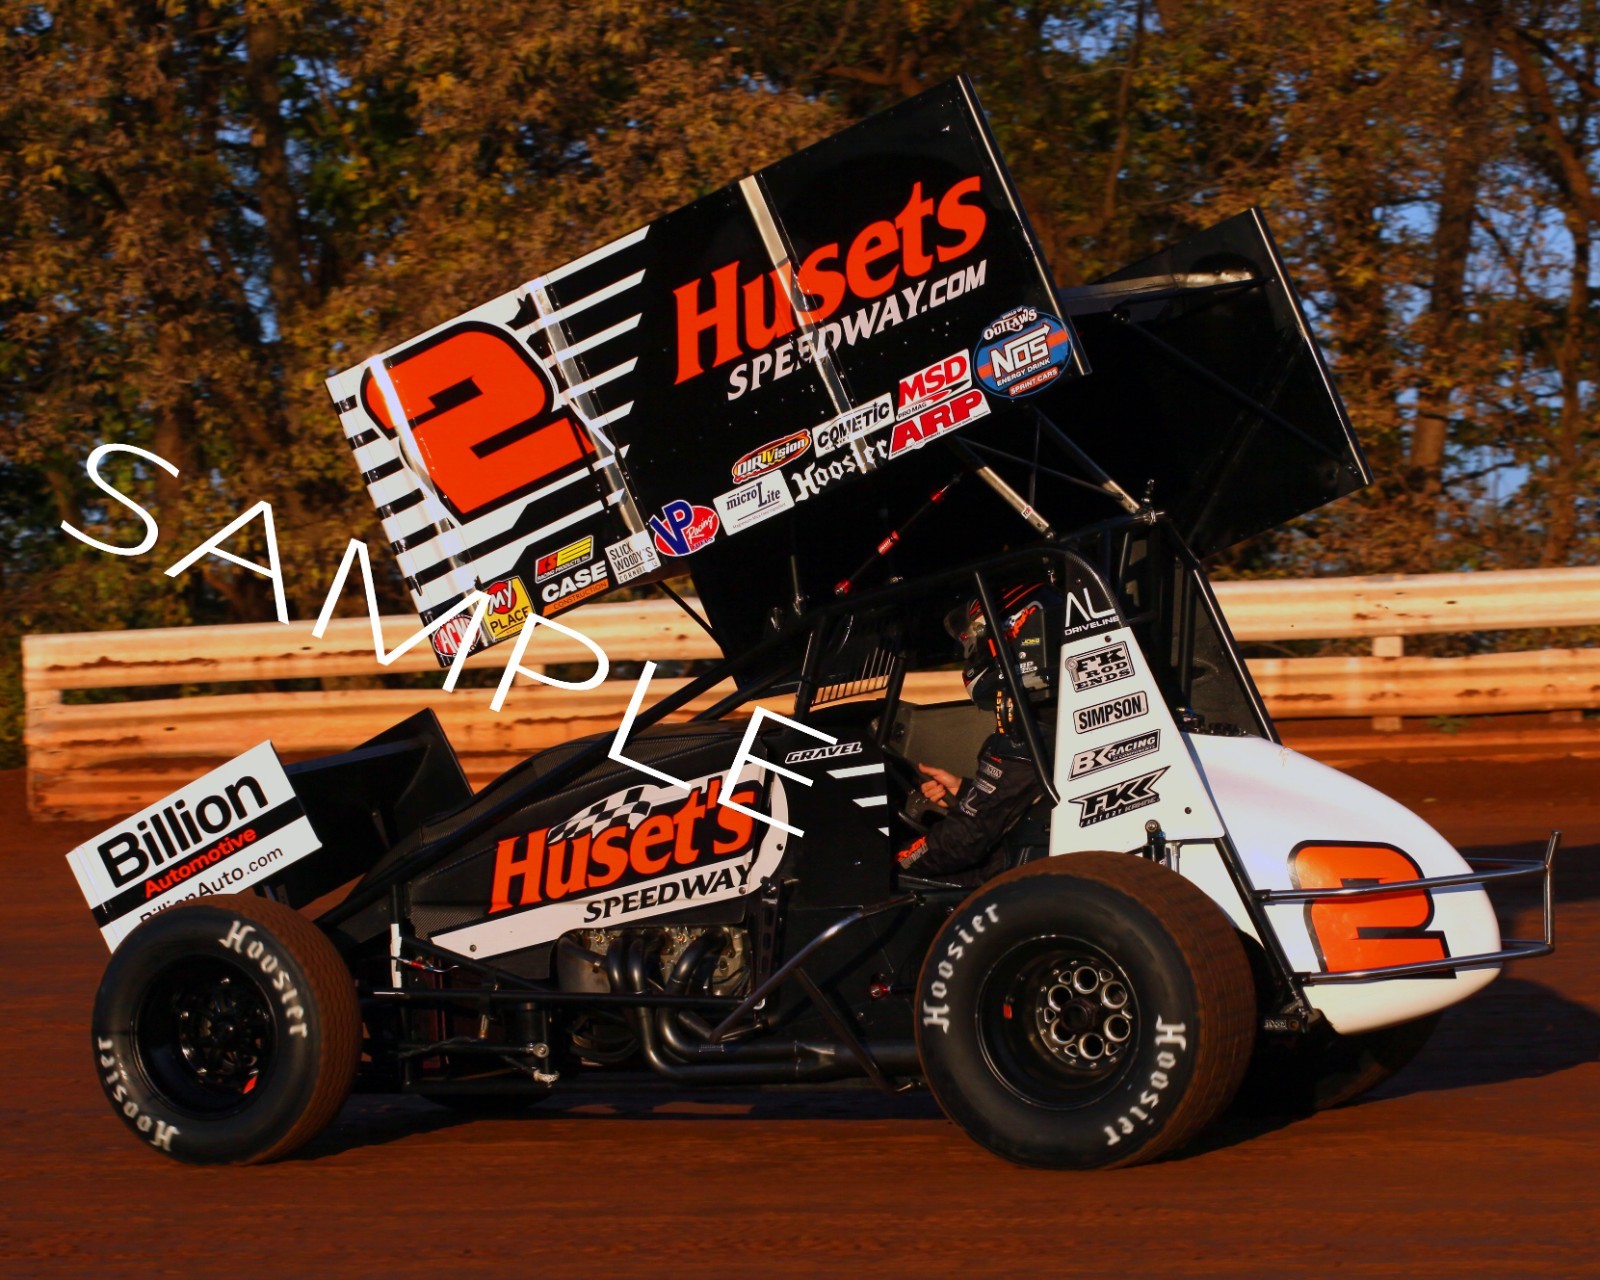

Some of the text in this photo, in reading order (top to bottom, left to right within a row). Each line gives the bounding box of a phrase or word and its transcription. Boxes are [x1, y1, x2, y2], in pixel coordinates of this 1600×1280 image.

[672, 175, 987, 386] Husets
[727, 260, 987, 400] SPEEDWAY.COM
[990, 324, 1051, 378] NOS
[898, 355, 967, 406] MSD
[997, 358, 1051, 386] ENERGY DRINK
[1010, 369, 1058, 395] SPRINT CARS
[361, 323, 605, 520] 2
[817, 402, 890, 446] COMETIC
[891, 390, 982, 451] ARP
[898, 401, 927, 419] PRO MAG
[792, 437, 889, 501] Hoosier
[609, 540, 634, 561] SLICK
[650, 500, 693, 555] VP
[686, 513, 715, 542] Racing
[614, 545, 654, 571] WOODY'S
[542, 561, 608, 603] CASE
[553, 581, 608, 610] CONSTRUCTION
[491, 605, 531, 633] PLACE
[1064, 615, 1120, 636] DRIVELINE
[1074, 647, 1126, 673] FK
[1075, 669, 1131, 690] ENDS
[1085, 661, 1127, 679] ROD
[1078, 695, 1143, 730] SIMPSON
[787, 743, 862, 763] GRAVEL
[1108, 735, 1157, 757] RACING
[97, 776, 269, 888] Billion
[489, 777, 755, 915] Huset's
[144, 829, 257, 899] Automotive
[584, 862, 753, 923] SPEEDWAY
[1287, 841, 1456, 978] 2
[218, 920, 308, 1038] Hoosier
[924, 902, 1000, 1034] Hoosier
[98, 1036, 180, 1151] Hoosier
[1104, 1014, 1187, 1145] Hoosier
